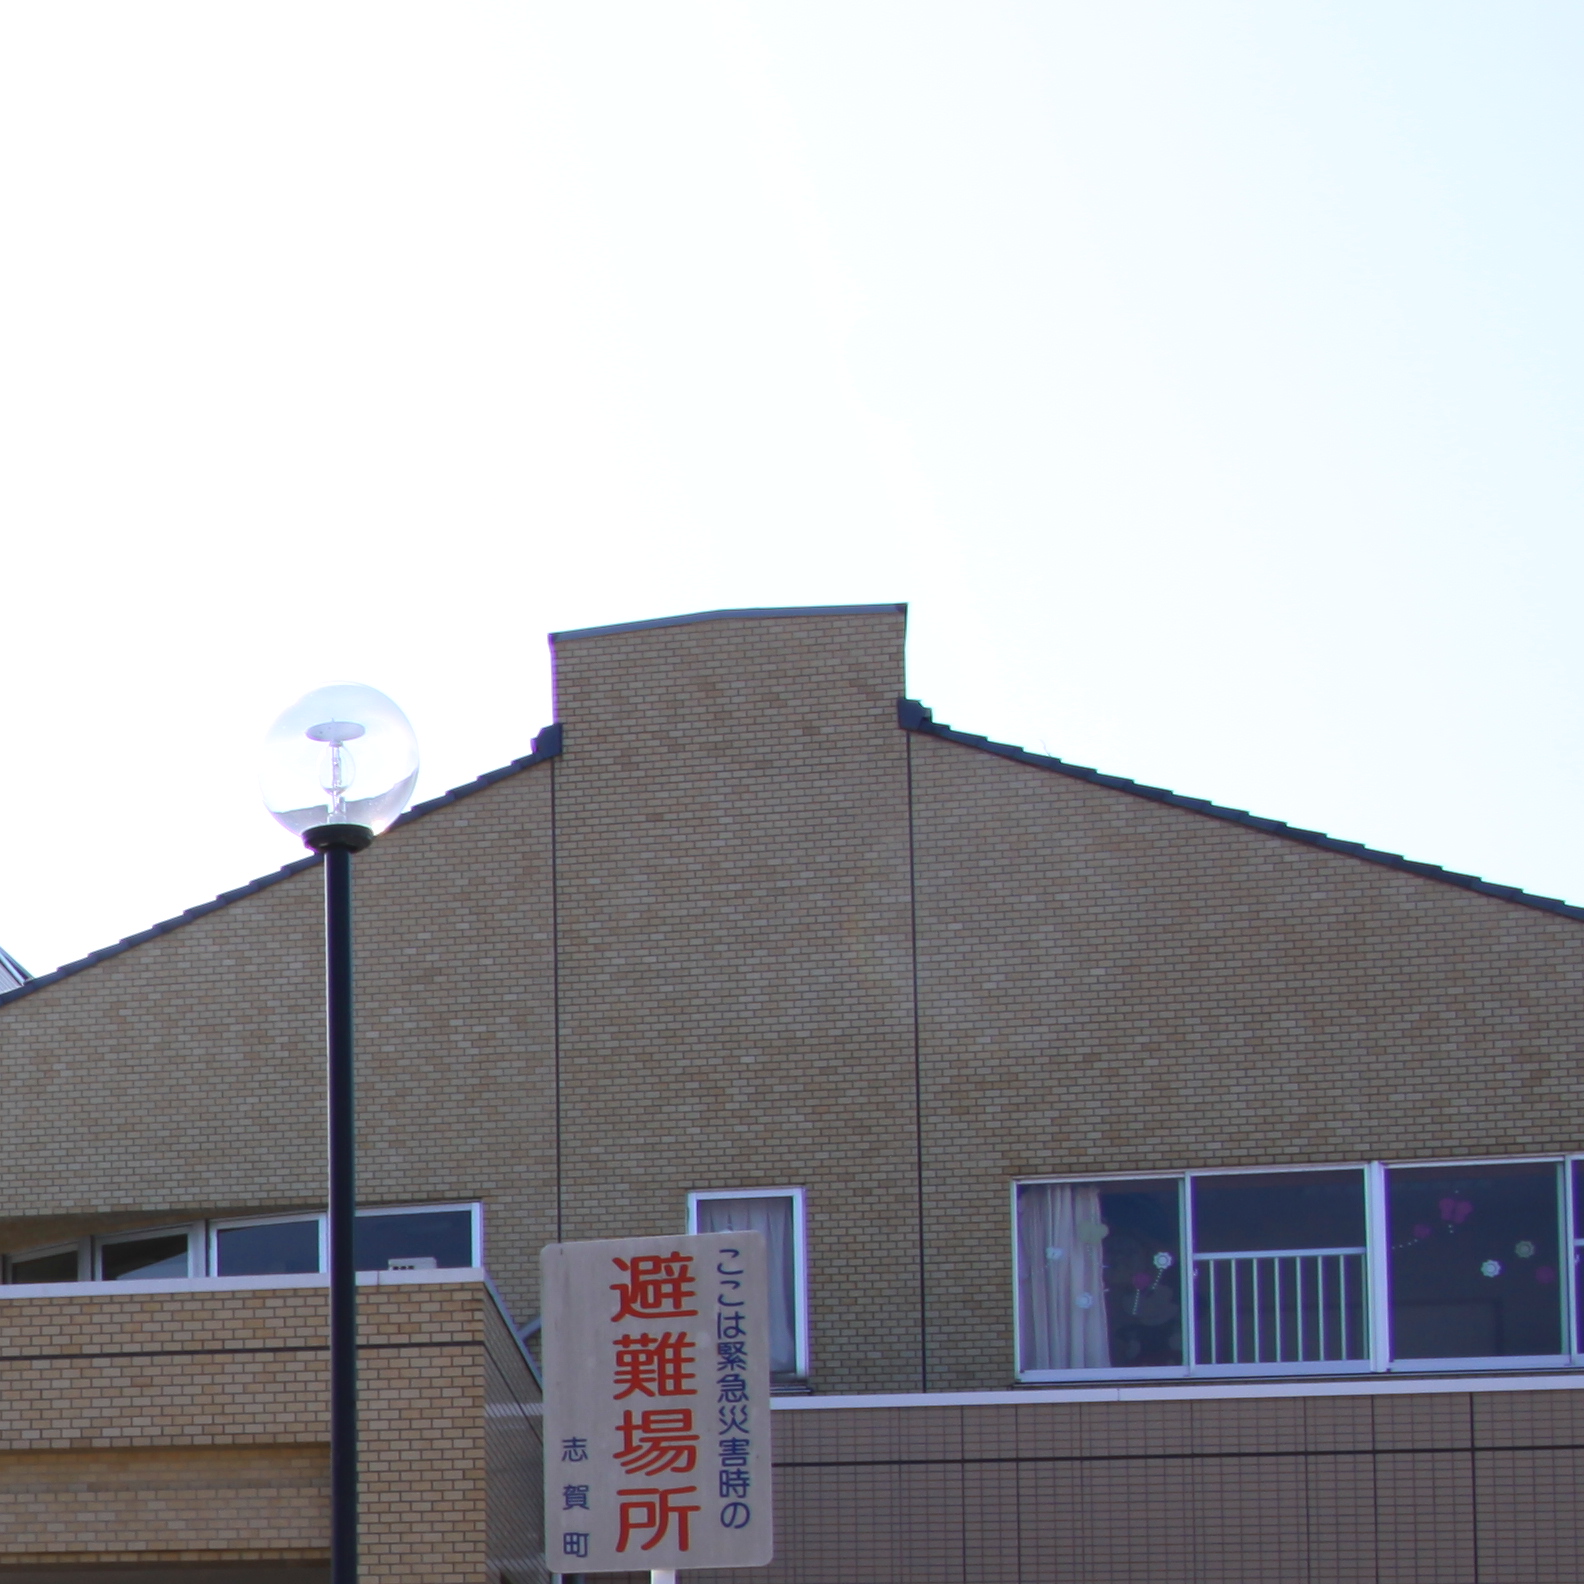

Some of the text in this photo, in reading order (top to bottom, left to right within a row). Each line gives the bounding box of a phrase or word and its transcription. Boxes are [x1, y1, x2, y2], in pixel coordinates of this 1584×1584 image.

[560, 1436, 590, 1559] 志賀町
[609, 1250, 701, 1553] 避難場所
[716, 1247, 751, 1530] ここは緊急災害時の
